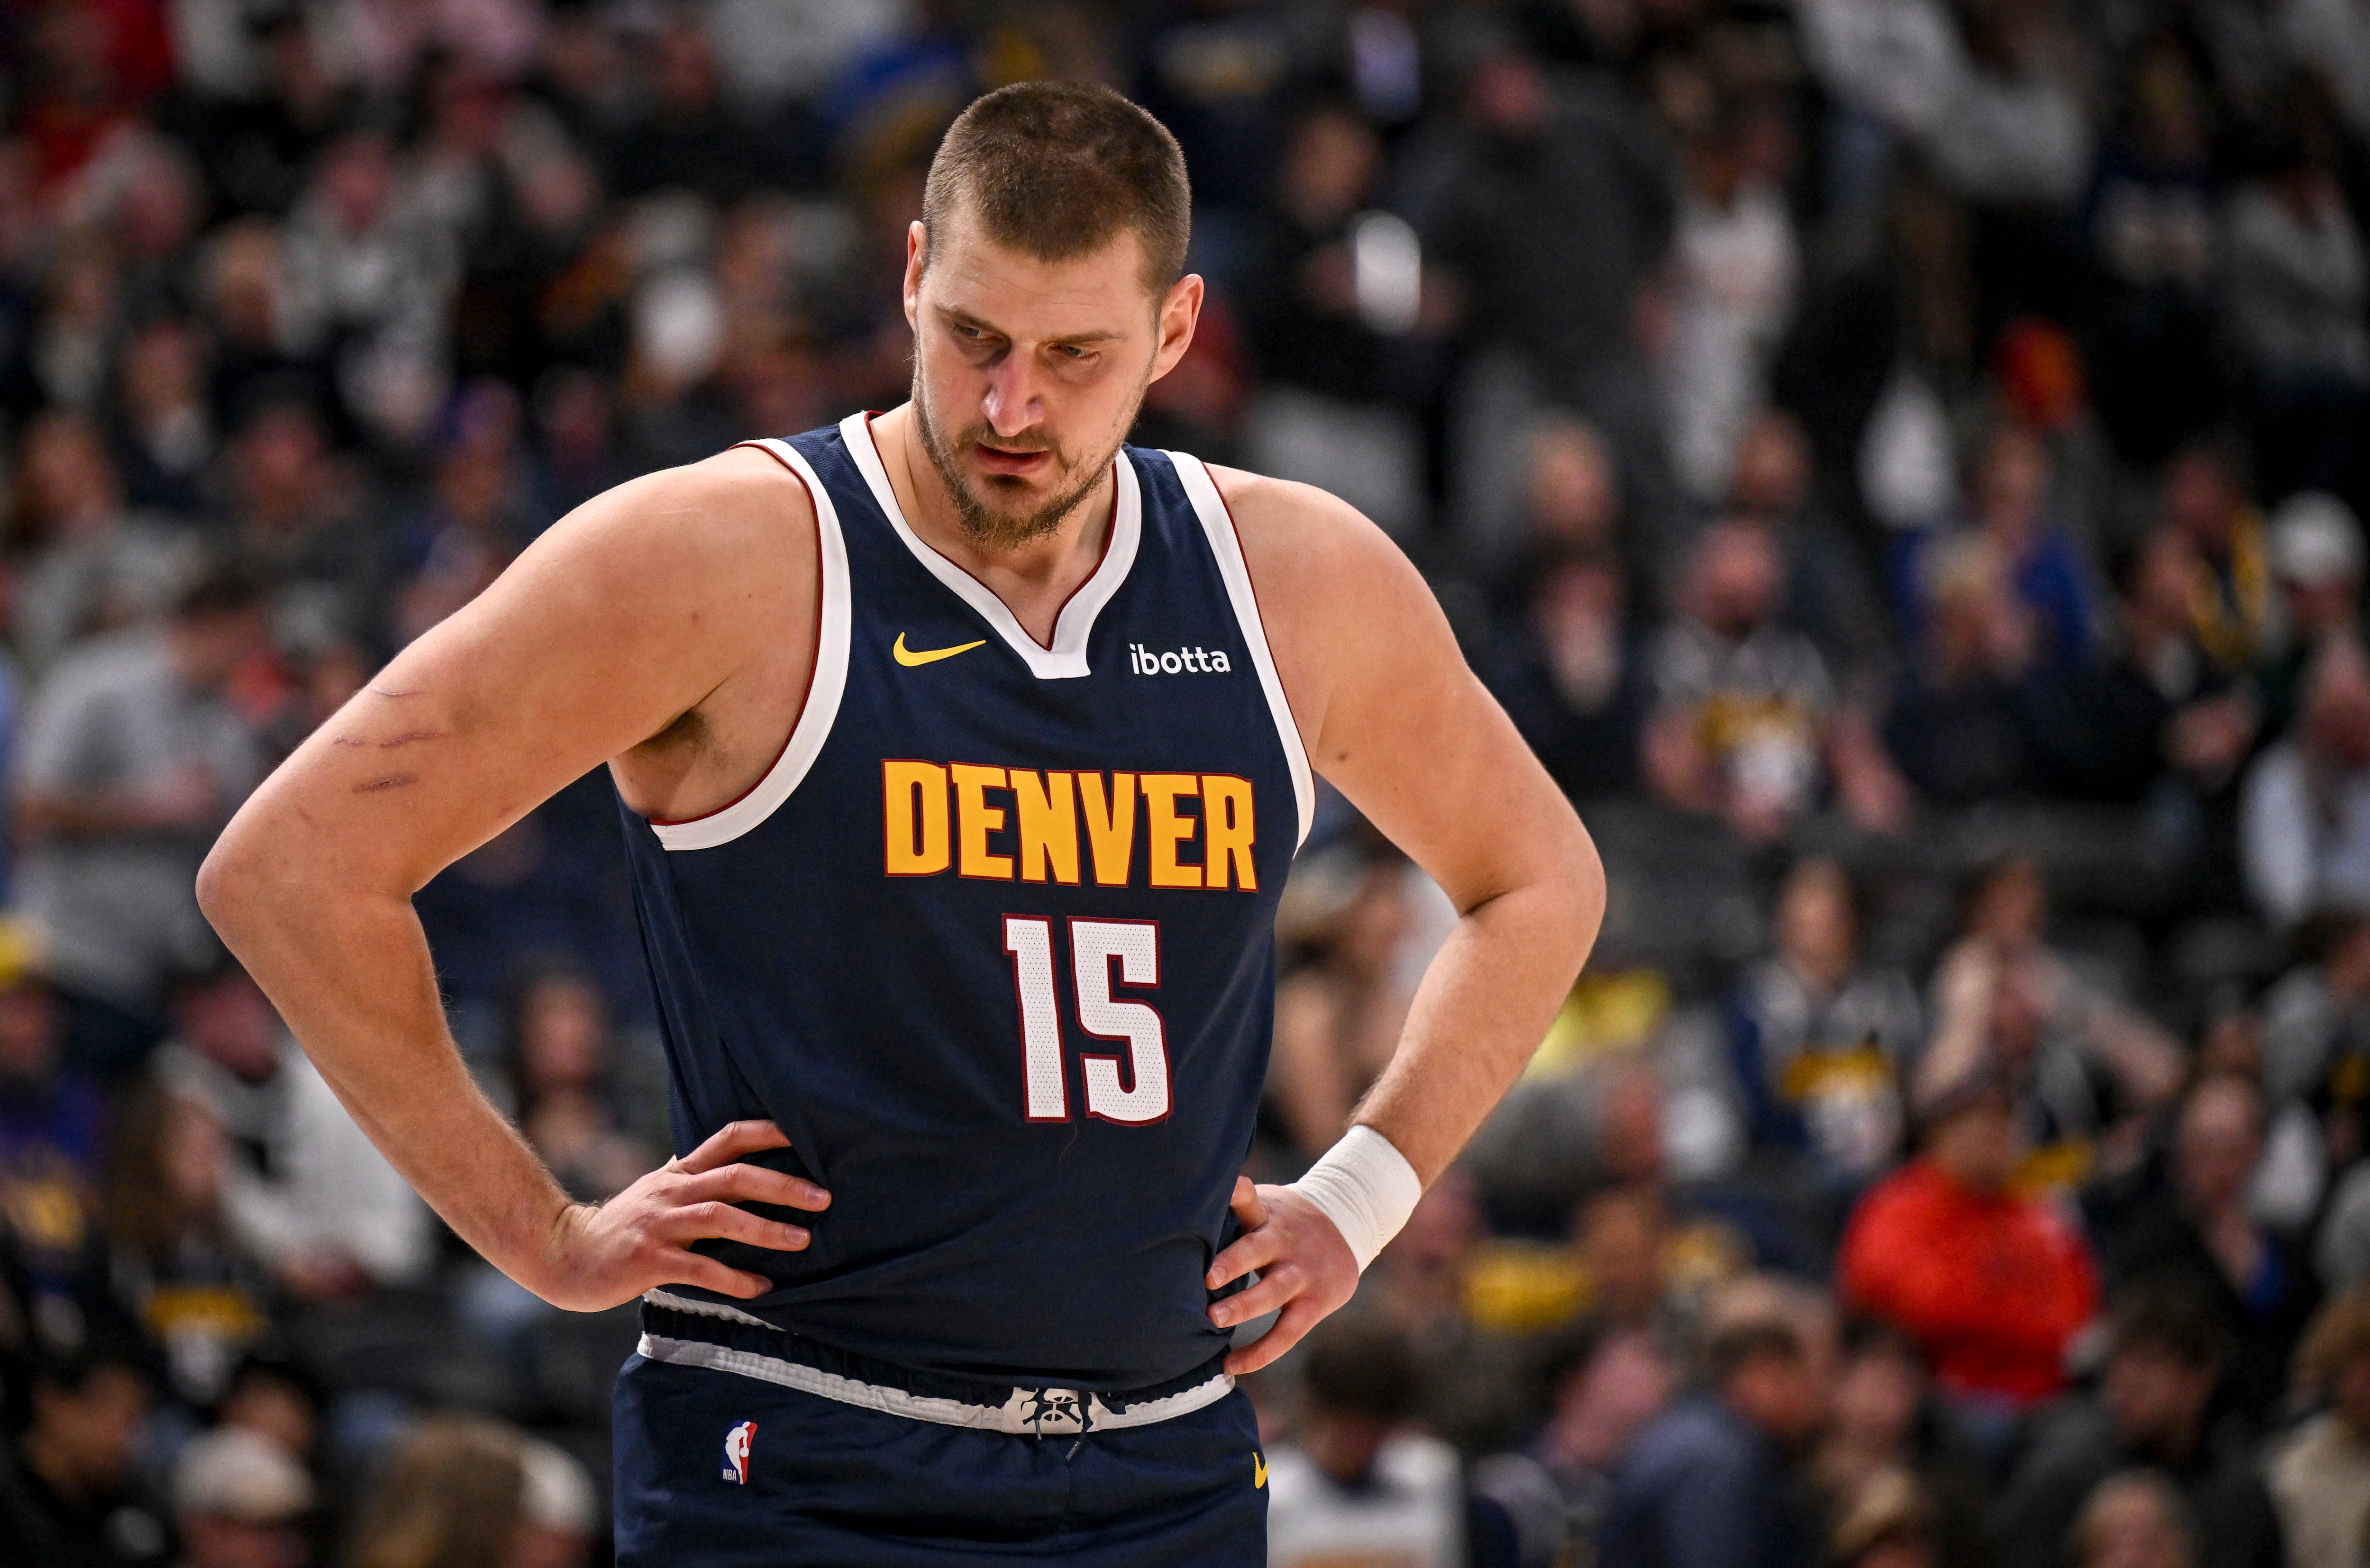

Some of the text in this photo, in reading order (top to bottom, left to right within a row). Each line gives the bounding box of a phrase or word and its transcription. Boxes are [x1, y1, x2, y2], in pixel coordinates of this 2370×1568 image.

[1130, 643, 1231, 675] ibotta
[881, 759, 1258, 892] DENVER
[1002, 914, 1174, 1125] 15
[723, 1469, 737, 1481] NBA
